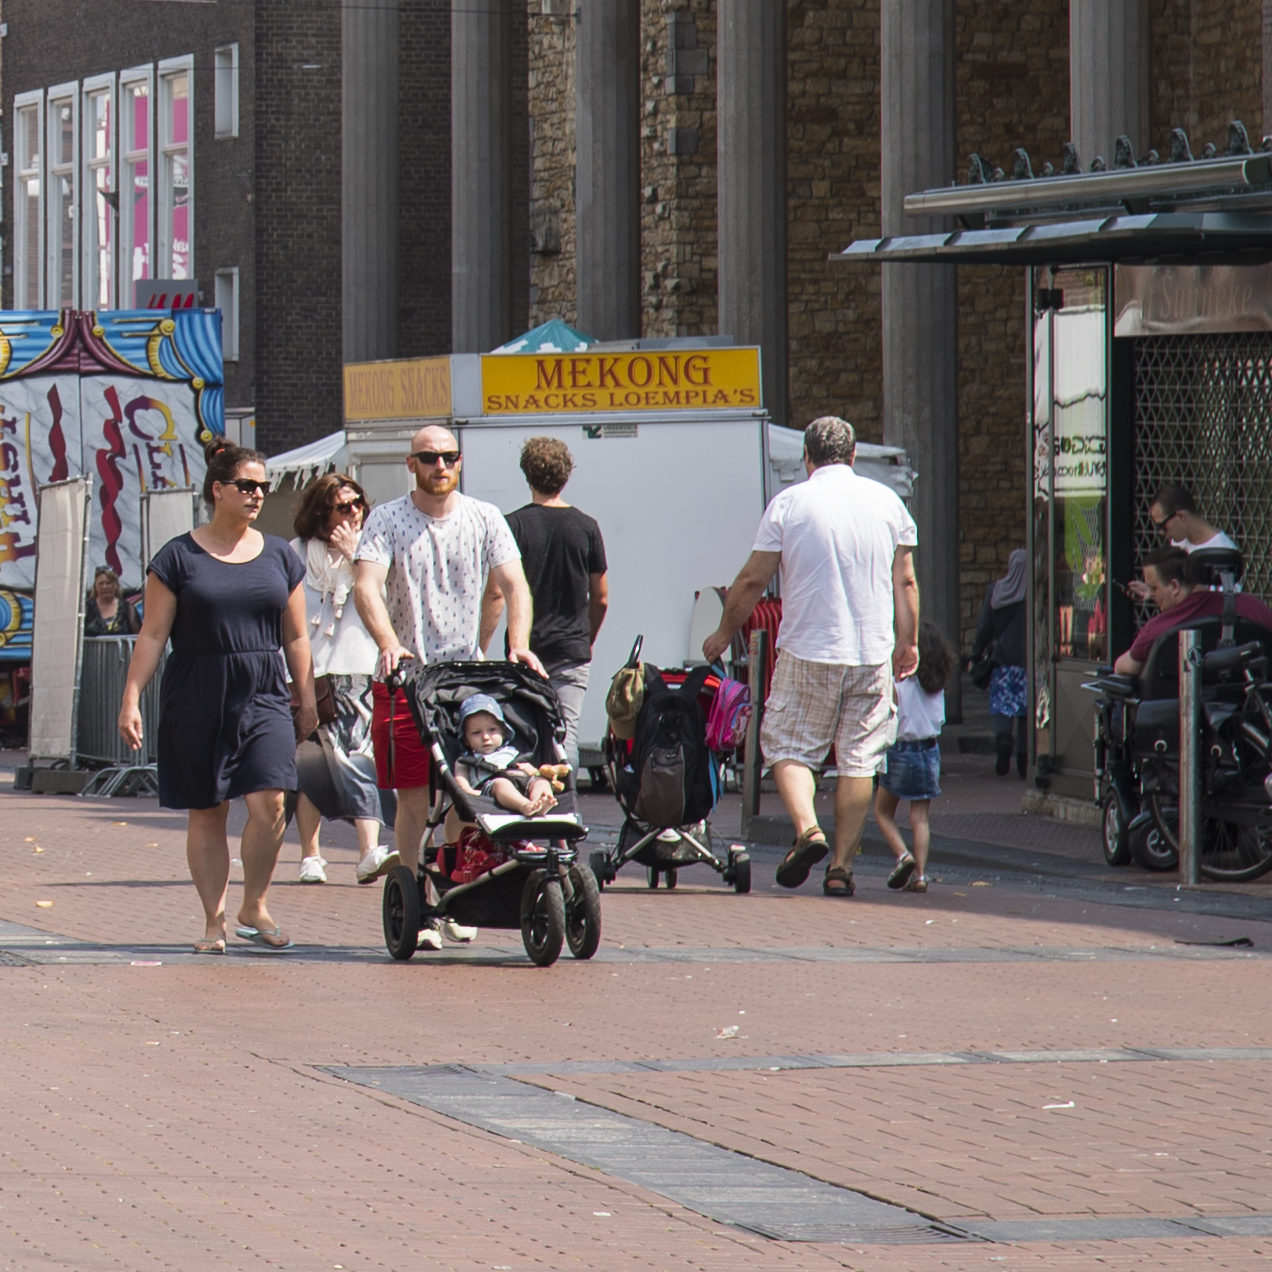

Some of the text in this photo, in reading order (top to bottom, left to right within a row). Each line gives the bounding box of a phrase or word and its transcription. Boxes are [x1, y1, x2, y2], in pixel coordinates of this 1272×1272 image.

[348, 366, 448, 411] MEKONG SNACKS
[534, 355, 714, 391] MEKONG
[487, 387, 755, 411] SNACKS LOEMPIA'S
